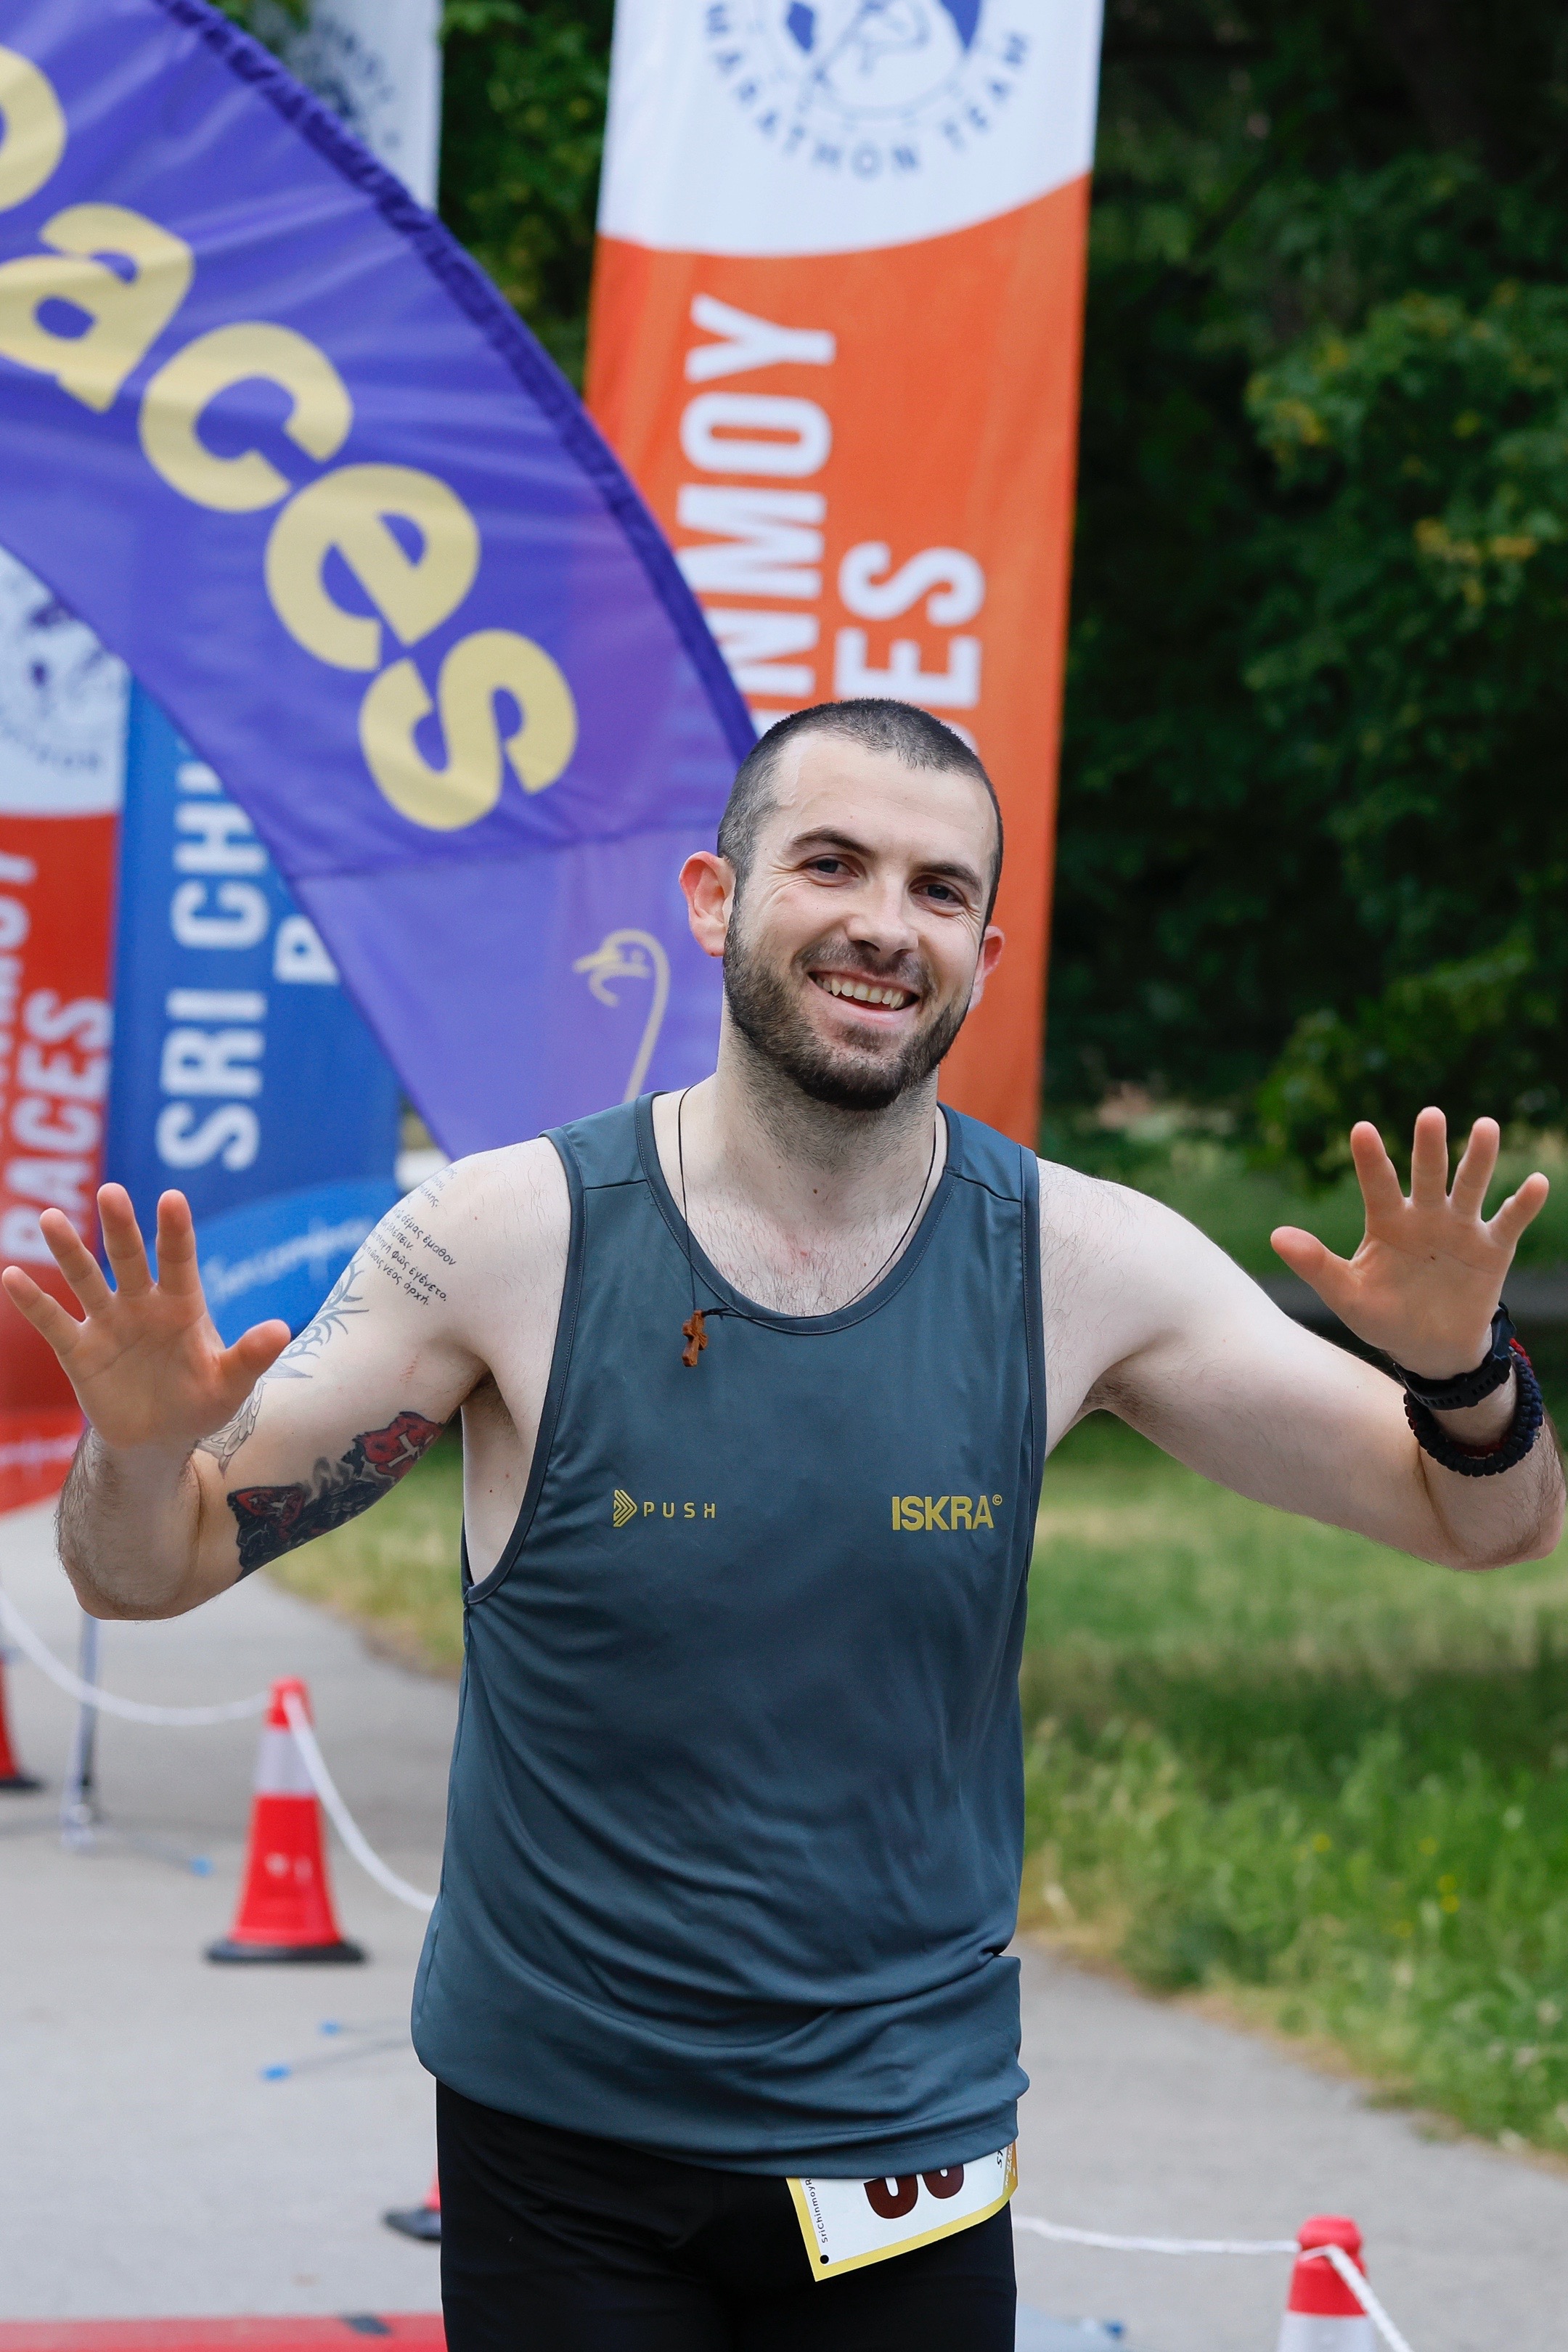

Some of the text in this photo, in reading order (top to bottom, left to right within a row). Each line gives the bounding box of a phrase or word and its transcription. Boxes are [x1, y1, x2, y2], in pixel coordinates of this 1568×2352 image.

[940, 30, 1031, 154] TEAM
[677, 293, 836, 737] NMOY
[155, 989, 268, 1171] SRI
[643, 1501, 716, 1519] PUSH
